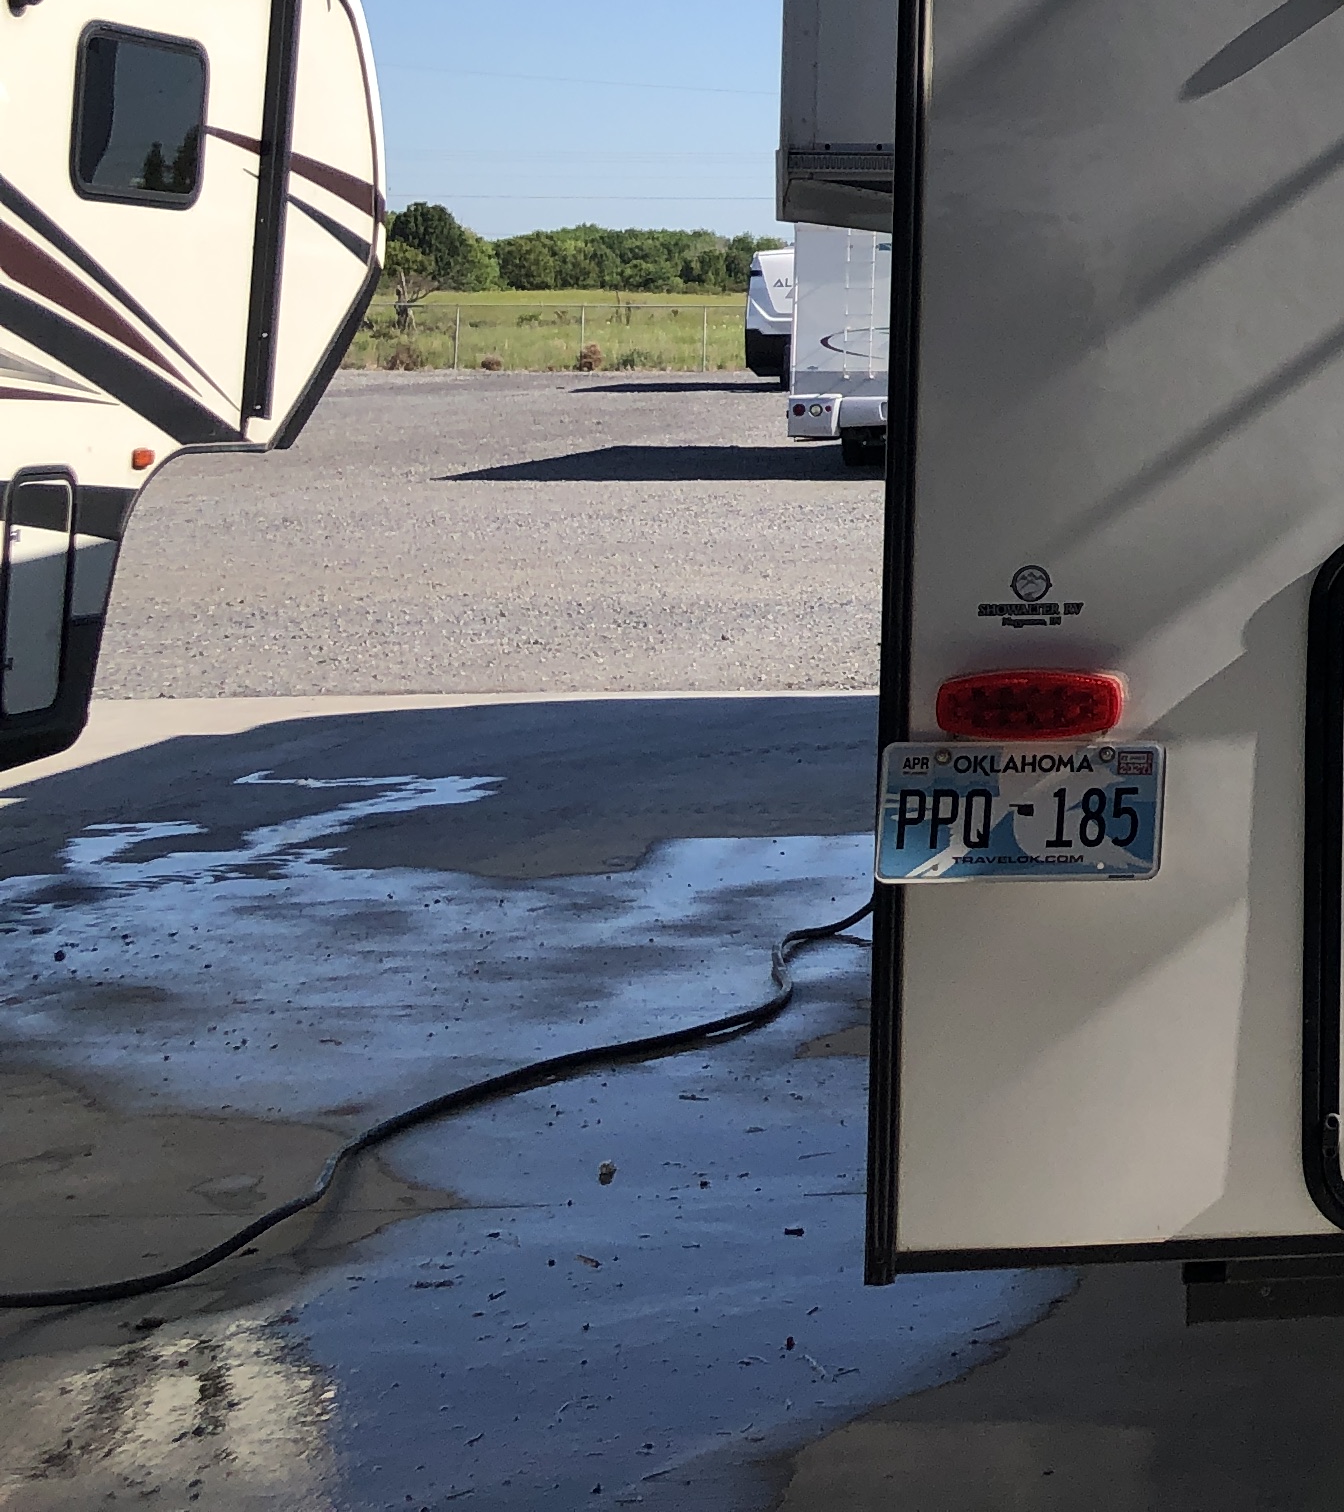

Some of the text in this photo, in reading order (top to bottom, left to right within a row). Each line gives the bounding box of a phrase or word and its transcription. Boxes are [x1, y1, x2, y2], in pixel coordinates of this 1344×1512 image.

[978, 602, 1084, 616] SHOWALTER RV
[903, 756, 929, 769] APR
[953, 754, 1094, 776] OKLAHOMA
[1045, 787, 1139, 849] 185
[951, 854, 1085, 865] TRAVELOK.COM
